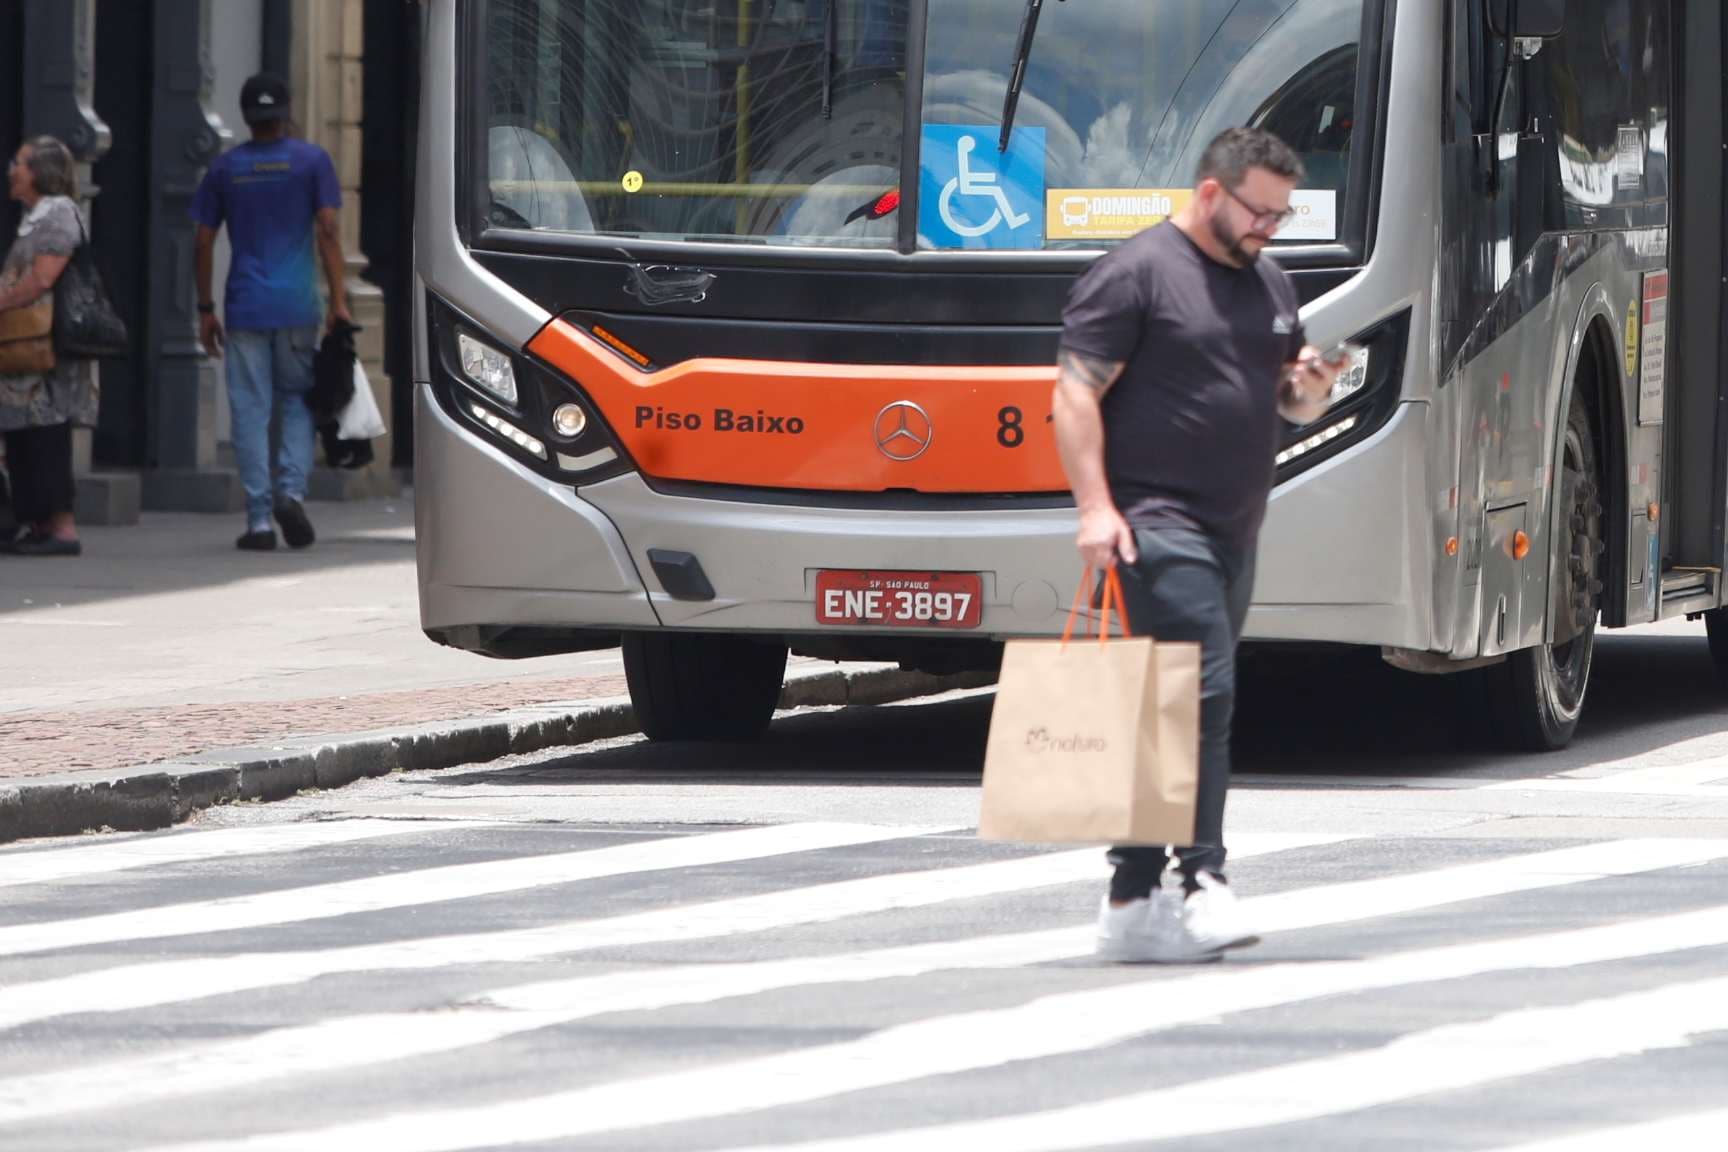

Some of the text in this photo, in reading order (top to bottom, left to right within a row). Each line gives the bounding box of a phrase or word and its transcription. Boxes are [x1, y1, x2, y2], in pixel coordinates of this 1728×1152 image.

[1091, 192, 1171, 216] DOMINGÃO
[634, 406, 804, 434] Piso Baixo
[996, 406, 1025, 448] 8
